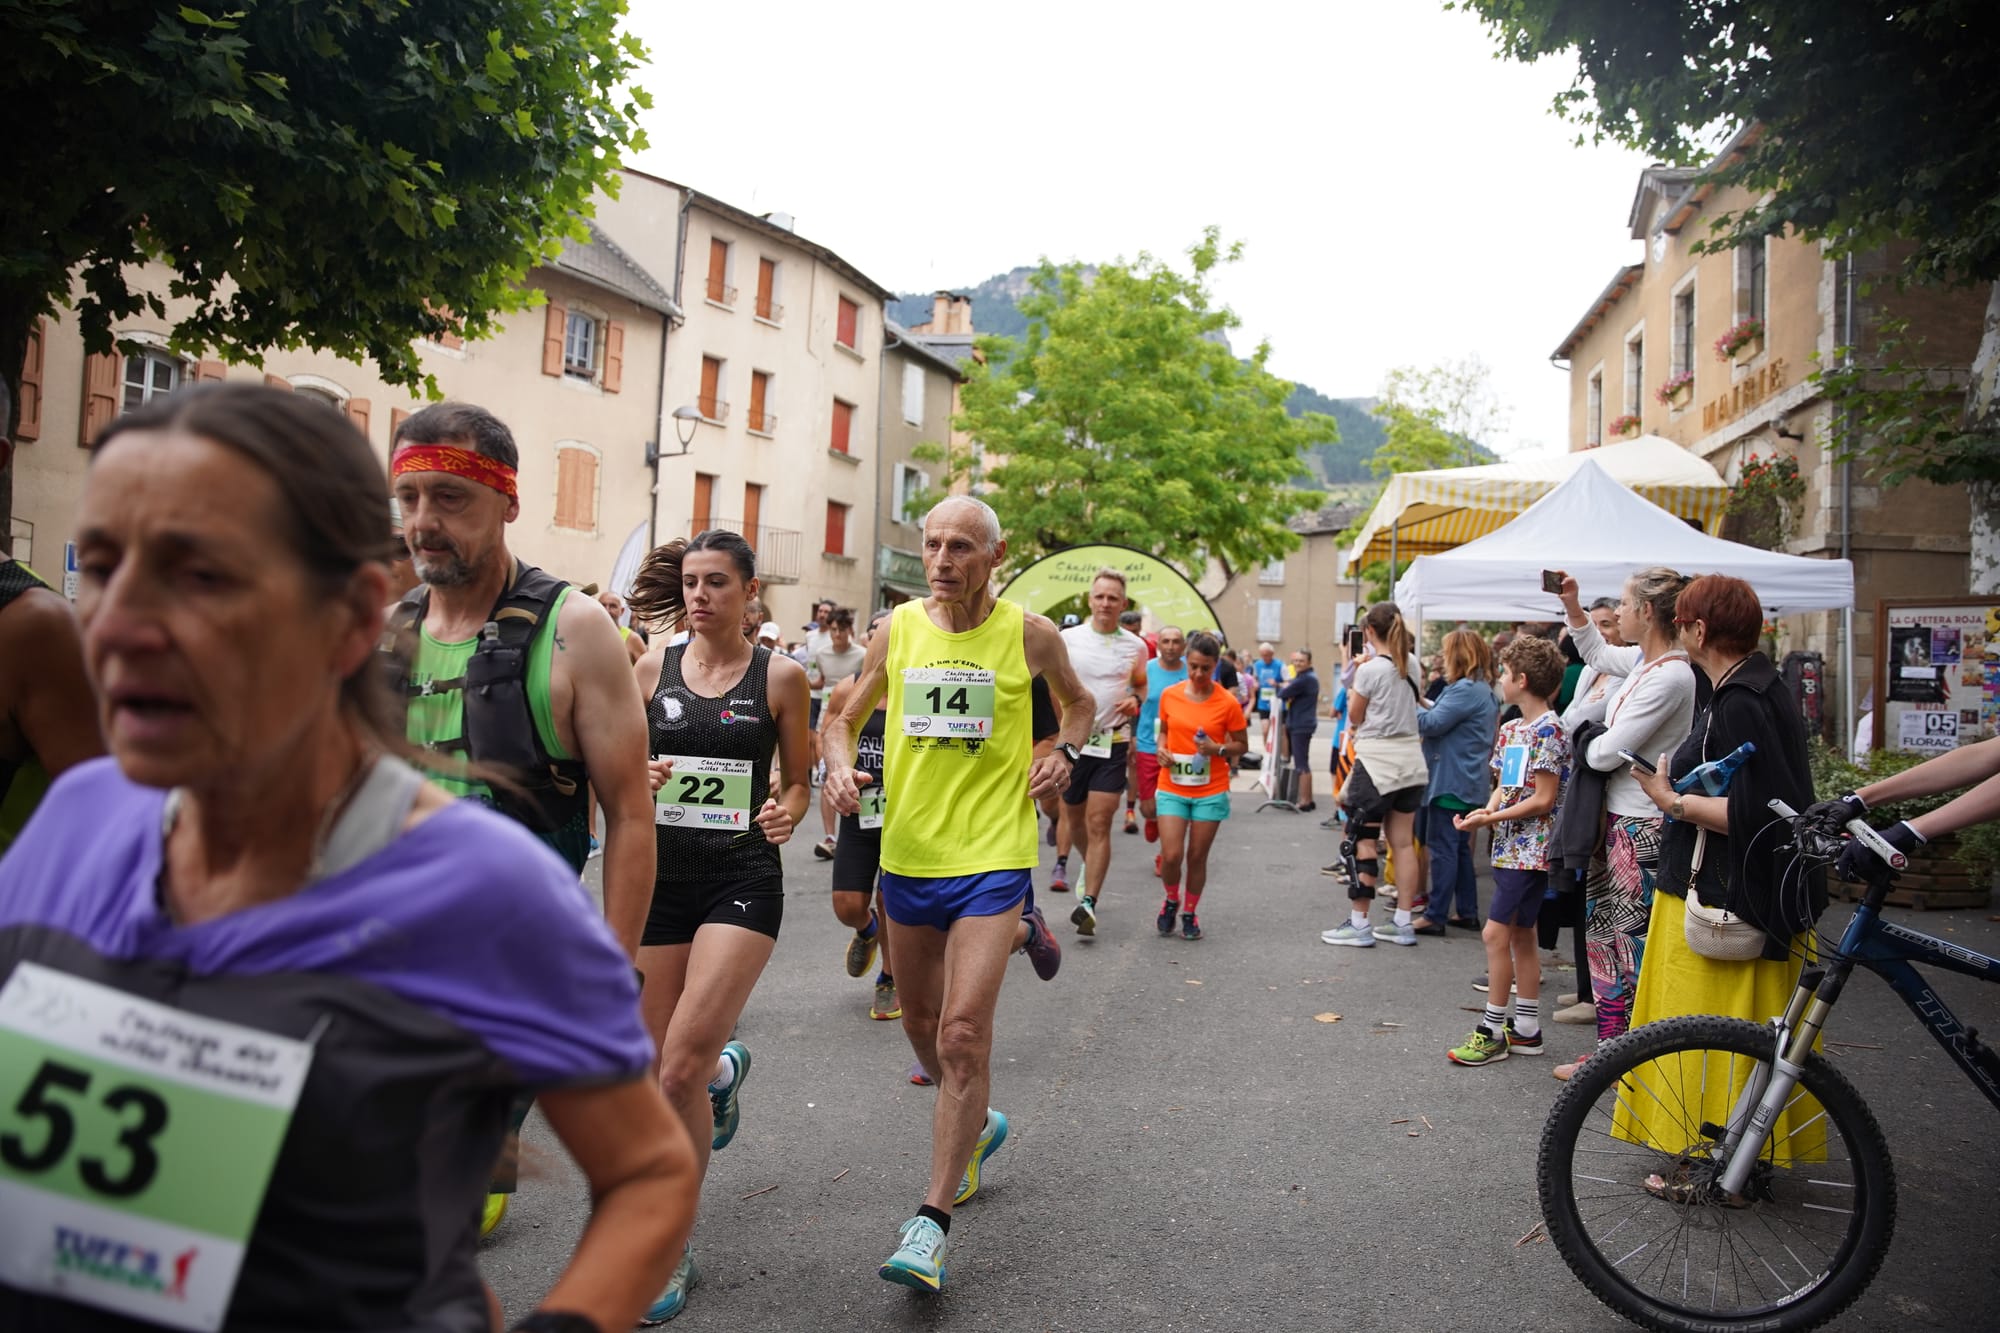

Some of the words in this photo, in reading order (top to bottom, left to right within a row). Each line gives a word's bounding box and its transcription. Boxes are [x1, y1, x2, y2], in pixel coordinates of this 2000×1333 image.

[1702, 358, 1783, 432] MAIRIE
[1056, 561, 1117, 571] Challe
[1125, 562, 1145, 571] des
[1890, 616, 1901, 624] LA
[1904, 616, 1952, 624] CAFETERA
[1954, 615, 1982, 624] ROJA
[944, 671, 975, 679] Challenge
[926, 687, 970, 714] 14
[1927, 714, 1955, 730] 05
[858, 735, 885, 752] AL
[1903, 737, 1952, 748] FLORAC
[701, 760, 732, 769] Challenge
[1507, 758, 1513, 775] 1
[678, 776, 725, 805] 22
[702, 812, 731, 820] TUFF'S
[0, 1059, 169, 1200] 53
[1640, 1305, 1781, 1333] SCHWALBE
